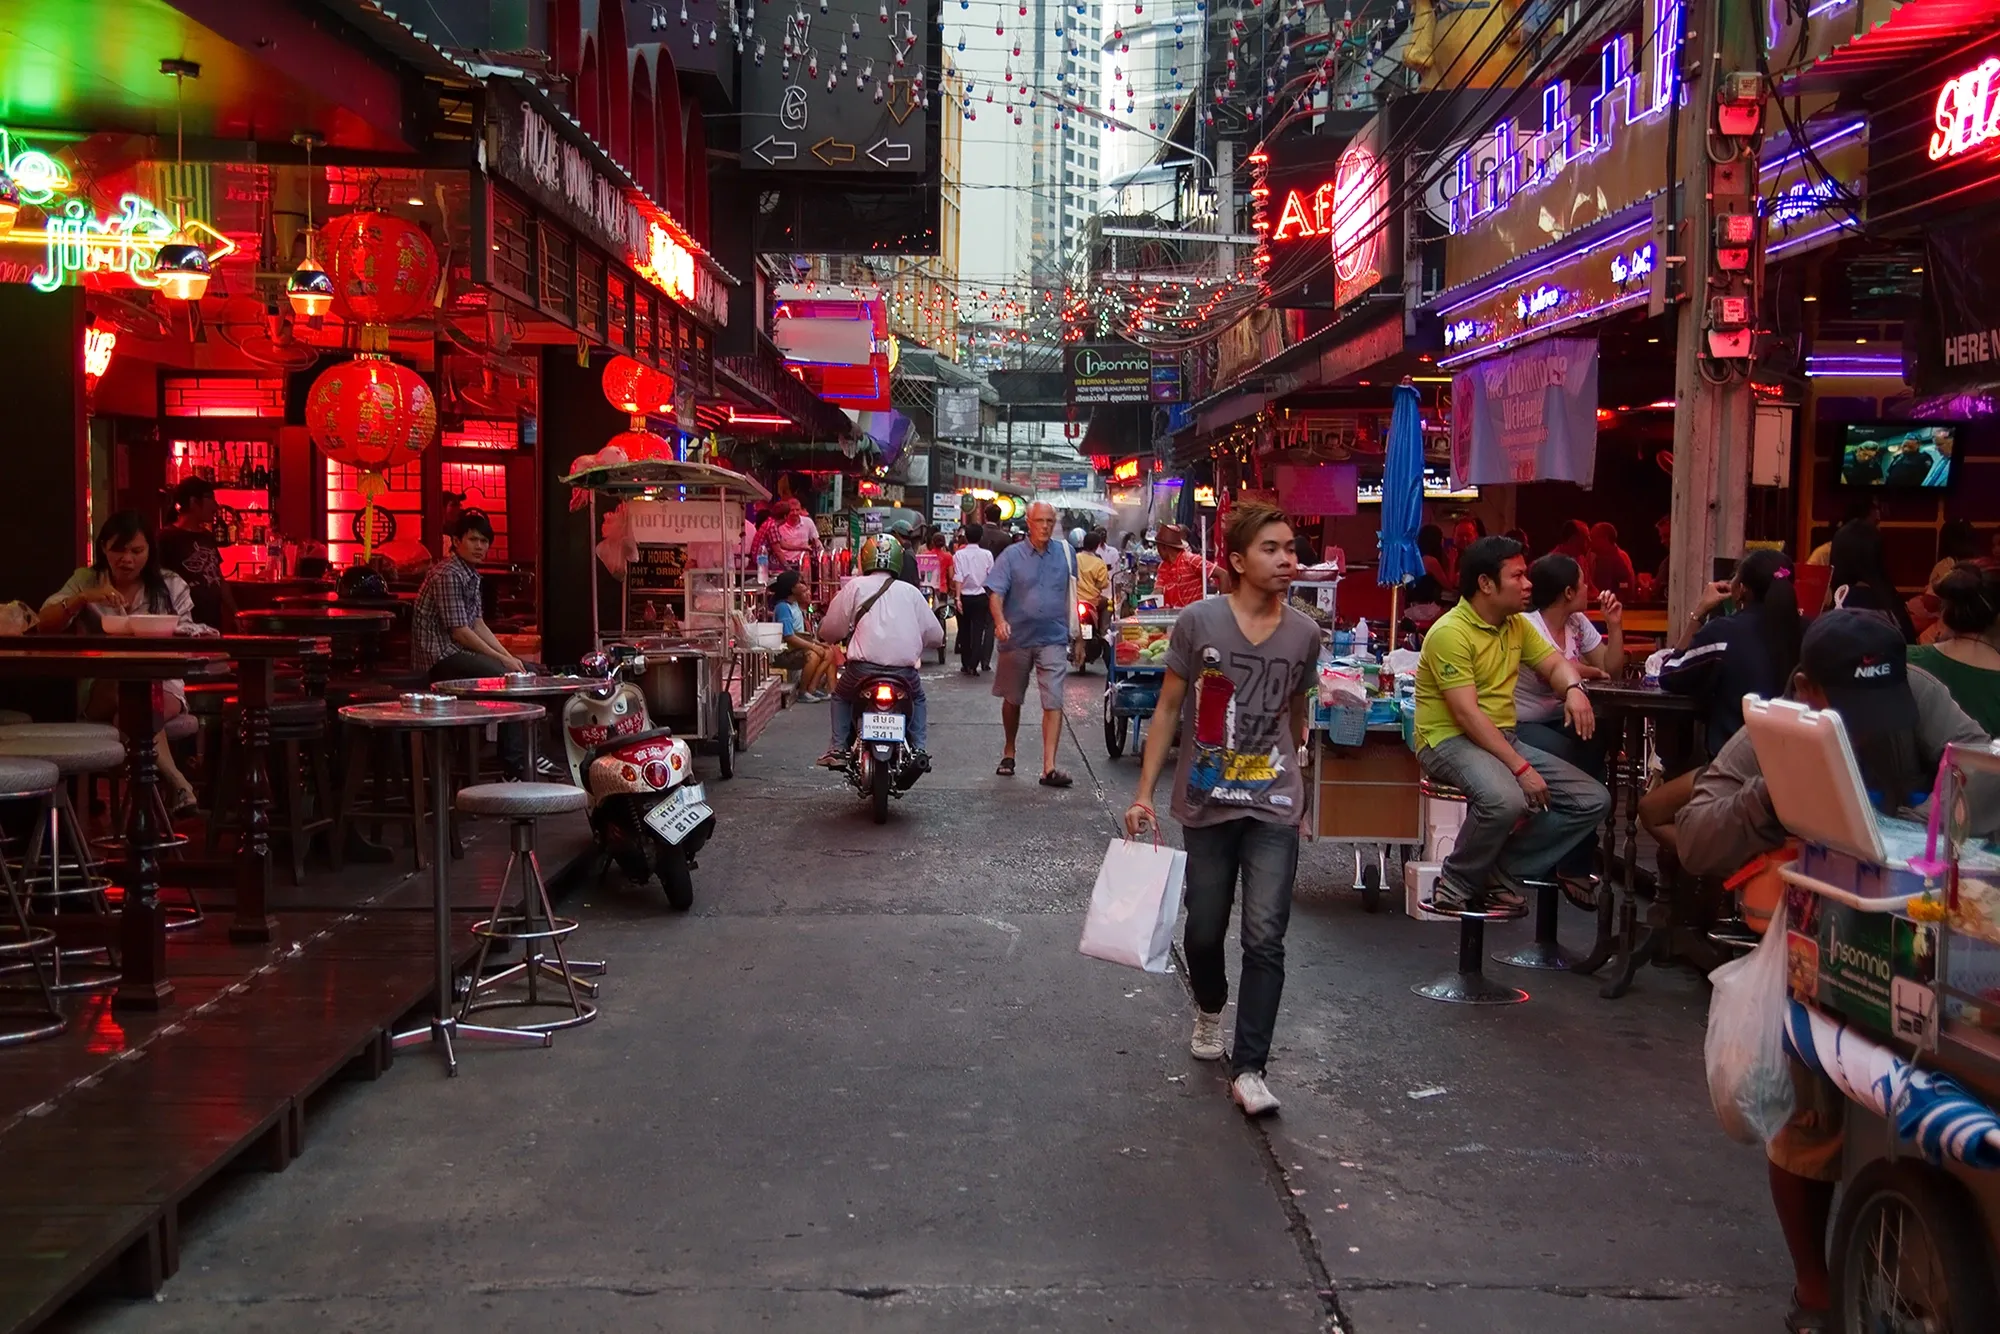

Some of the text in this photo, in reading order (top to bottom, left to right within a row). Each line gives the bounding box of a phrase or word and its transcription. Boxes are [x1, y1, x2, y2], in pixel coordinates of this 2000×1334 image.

[1945, 331, 1989, 367] HERE
[647, 550, 675, 563] HOURS
[1854, 663, 1891, 678] NIKE
[872, 731, 893, 739] 341
[674, 811, 700, 833] 810
